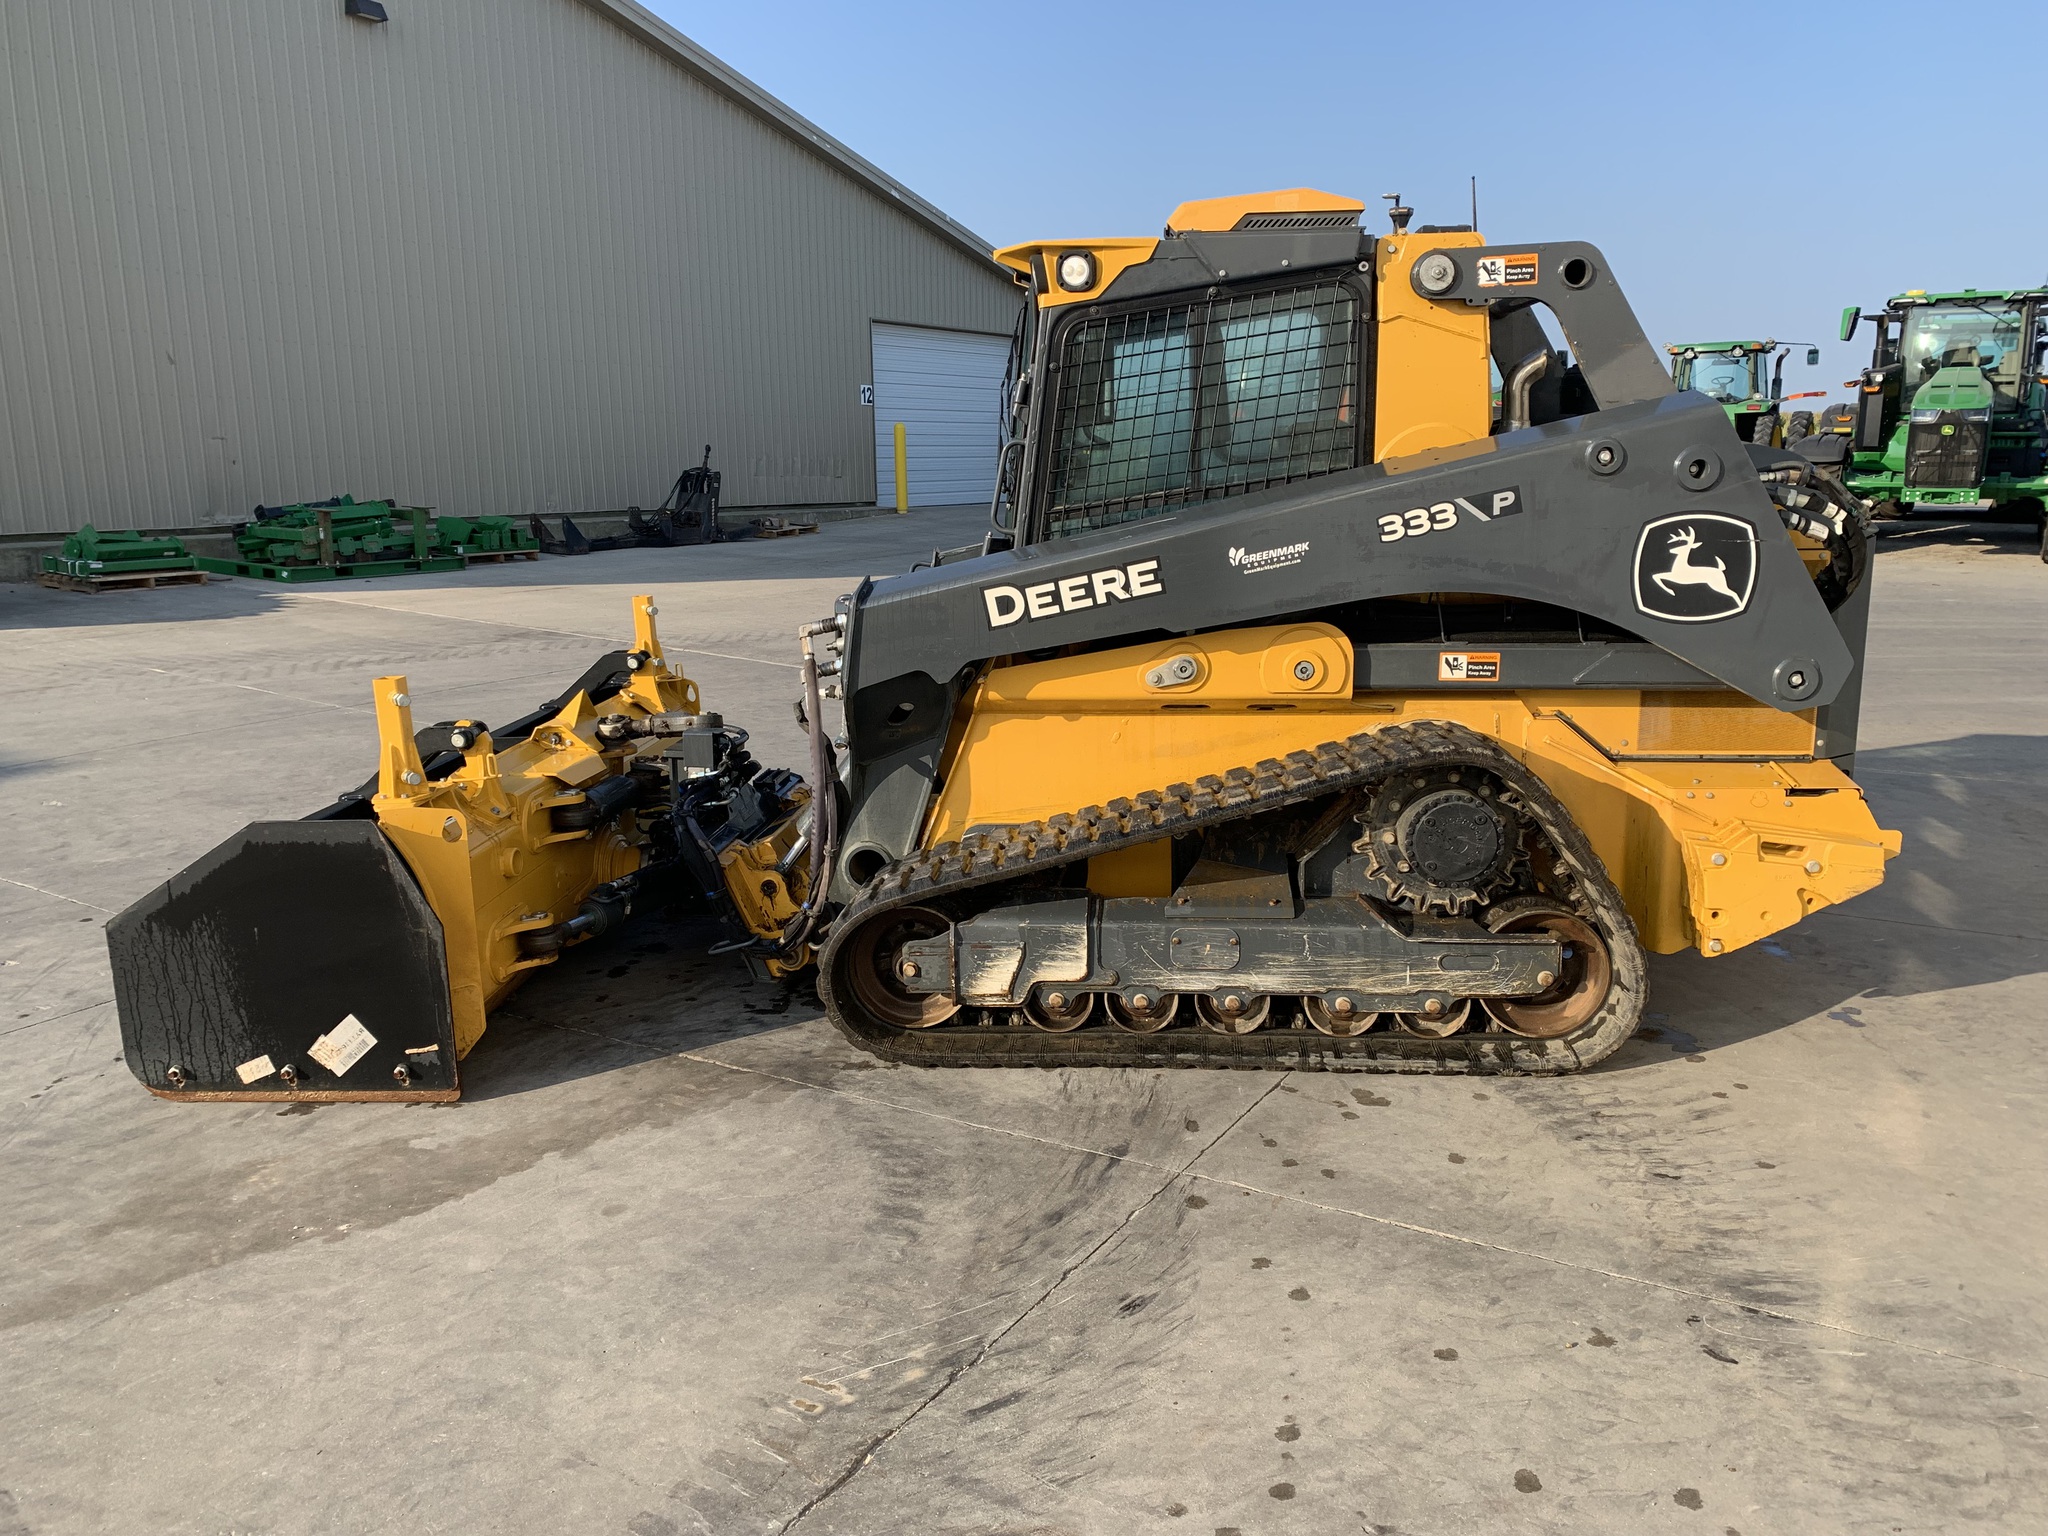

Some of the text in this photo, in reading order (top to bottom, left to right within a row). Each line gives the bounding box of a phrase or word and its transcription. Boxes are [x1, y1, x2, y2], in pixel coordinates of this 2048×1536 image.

[861, 386, 873, 404] 12
[1377, 502, 1458, 542] 333
[1241, 541, 1310, 565] GREENMARK
[1247, 551, 1305, 568] EQUIPMENT
[983, 560, 1163, 628] DEERE
